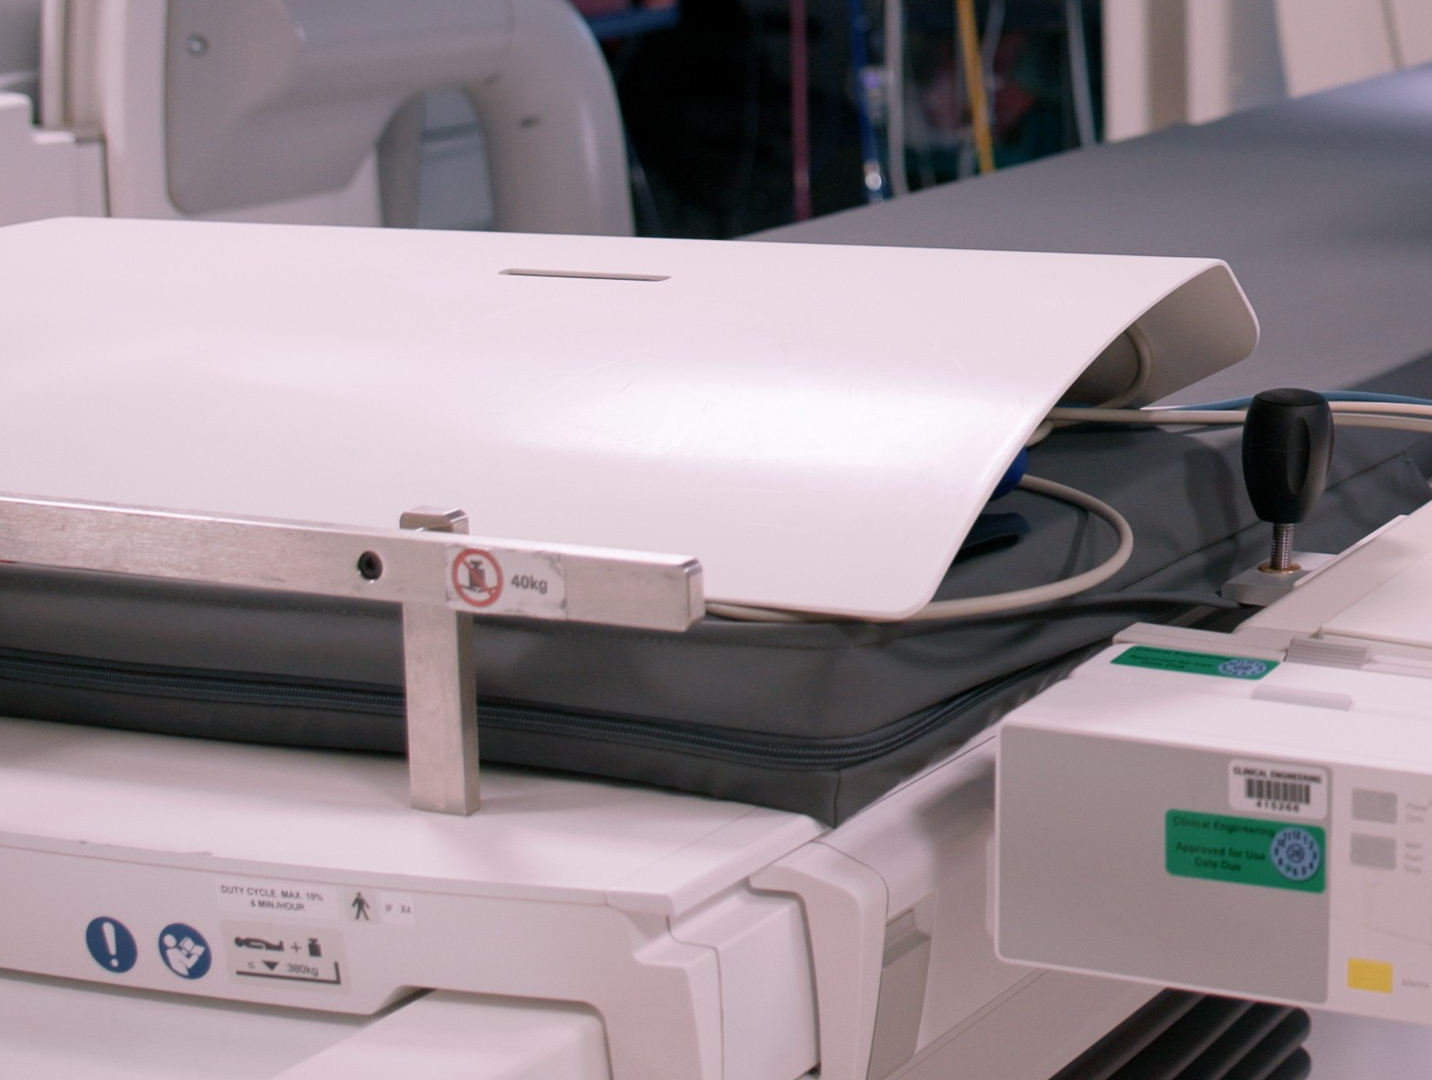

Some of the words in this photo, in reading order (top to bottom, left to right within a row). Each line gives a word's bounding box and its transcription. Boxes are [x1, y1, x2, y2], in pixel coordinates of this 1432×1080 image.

[511, 575, 548, 594] 40kg
[1233, 766, 1267, 777] CLINICAL
[1270, 770, 1322, 783] ENGINEERING
[1172, 815, 1210, 828] Clinical
[1213, 820, 1276, 839] Engineering
[1176, 842, 1226, 857] Approved
[1228, 847, 1243, 858] for
[1245, 850, 1266, 861] Use
[1220, 860, 1242, 871] Due
[220, 885, 244, 895] DUTY
[306, 892, 324, 902] 10%
[287, 963, 319, 977] 380kg
